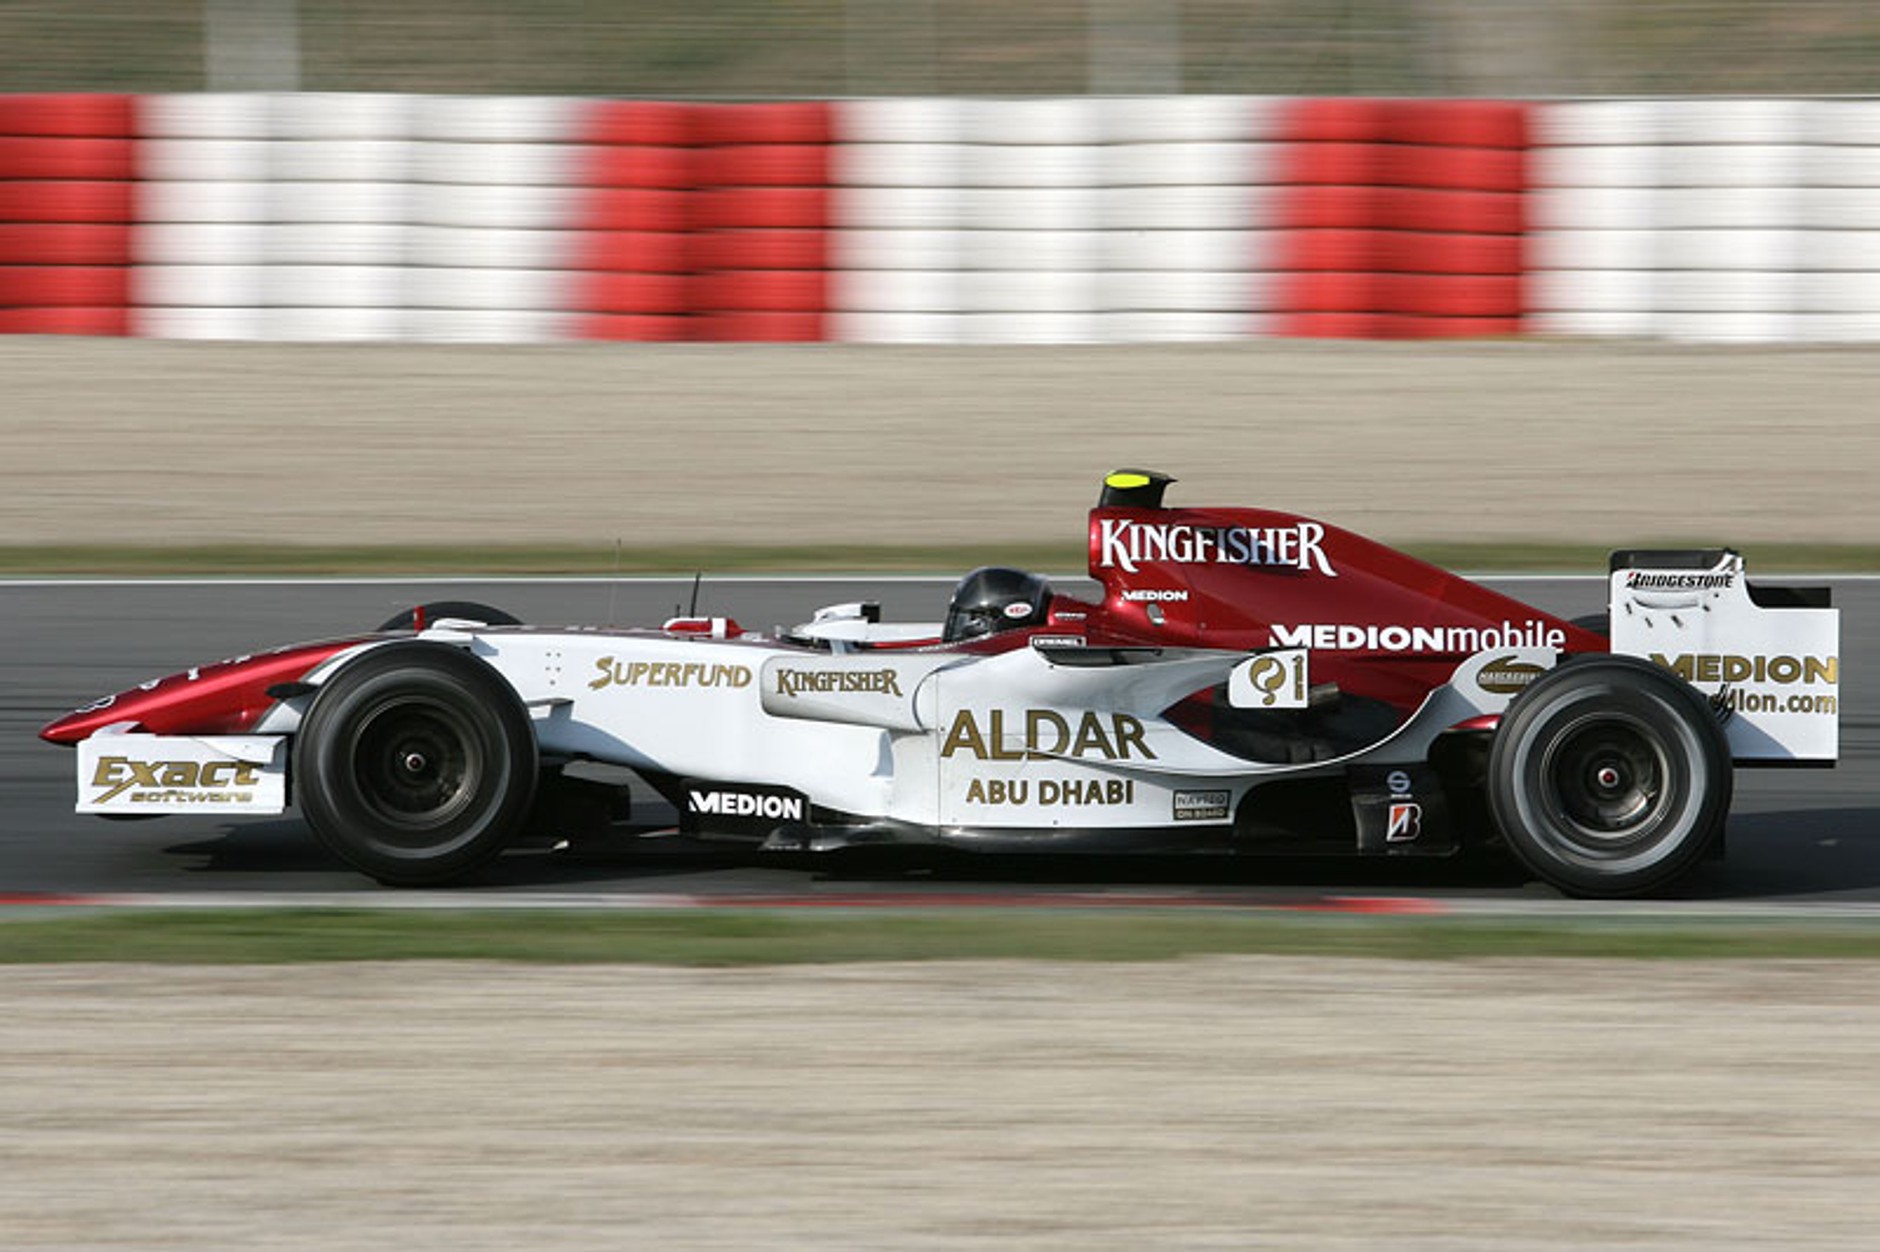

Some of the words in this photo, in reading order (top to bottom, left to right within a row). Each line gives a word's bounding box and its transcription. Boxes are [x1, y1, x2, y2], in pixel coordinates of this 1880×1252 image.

[1099, 519, 1338, 577] KINGFISHER
[1625, 571, 1735, 589] BRIDGESTONE
[1121, 589, 1189, 602] MEDION
[1269, 620, 1565, 653] MEDIONmobile
[588, 656, 752, 689] SUPERFUND
[776, 669, 904, 697] KINGFISHER
[1650, 653, 1838, 684] MEDION
[940, 709, 1158, 760] ALDAR
[92, 756, 260, 804] Exact
[966, 779, 1029, 805] ABU
[1038, 780, 1134, 805] DHABI
[130, 789, 253, 803] software
[689, 791, 802, 820] MEDION
